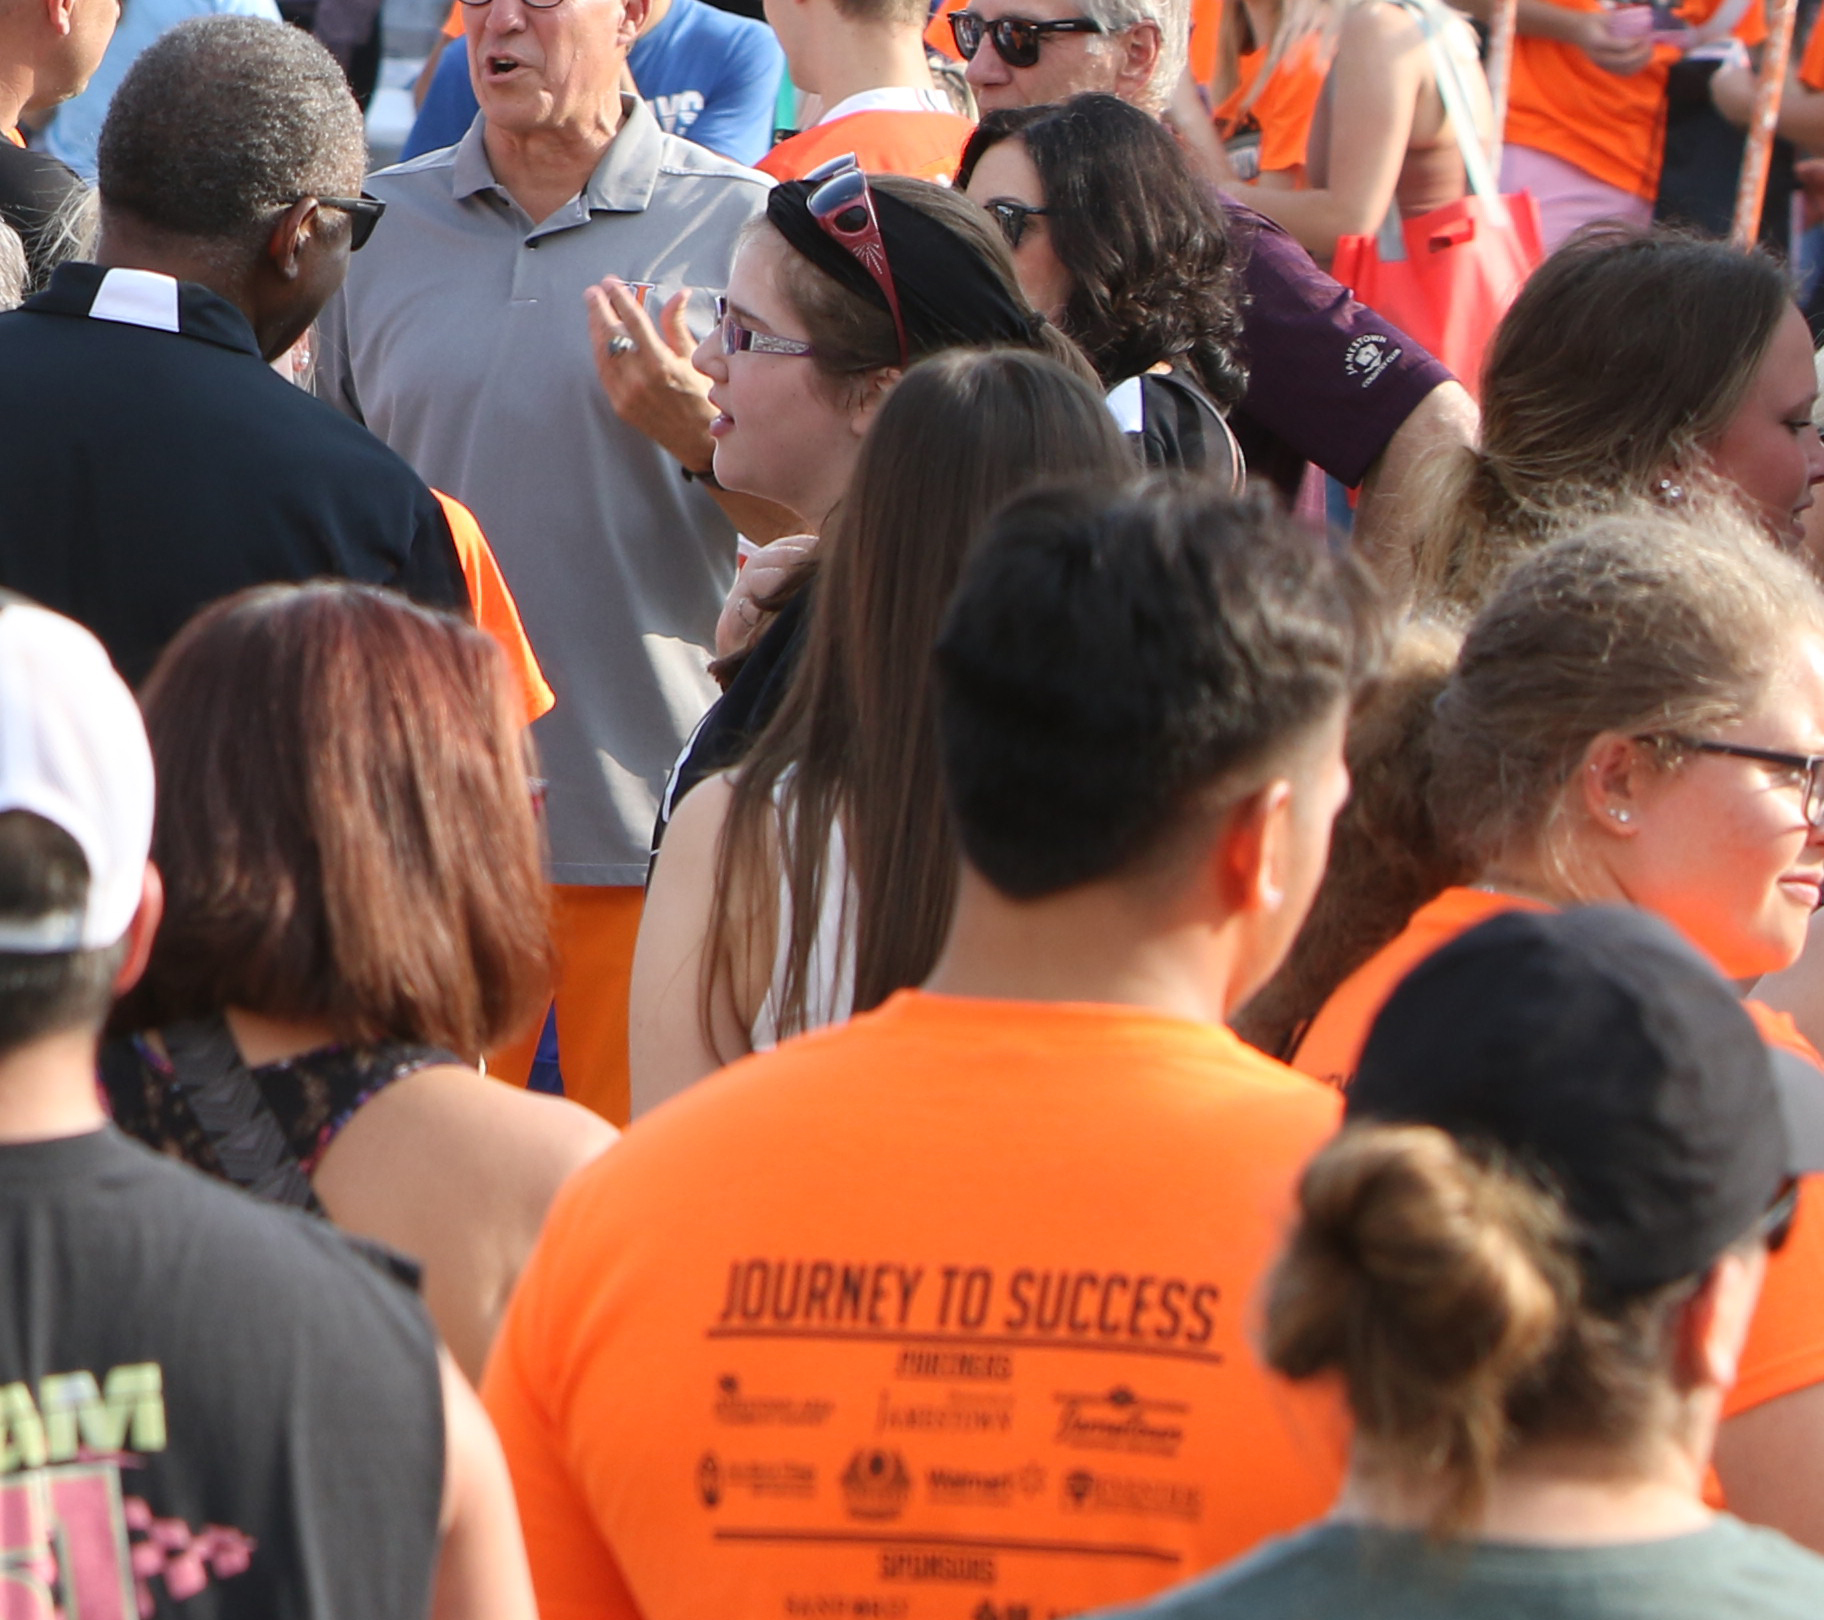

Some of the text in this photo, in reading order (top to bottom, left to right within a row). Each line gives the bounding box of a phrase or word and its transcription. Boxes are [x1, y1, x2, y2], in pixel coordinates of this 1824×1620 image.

[1344, 334, 1388, 376] JAMESTOWN
[718, 1257, 1221, 1347] JOURNEY TO SUCCESS
